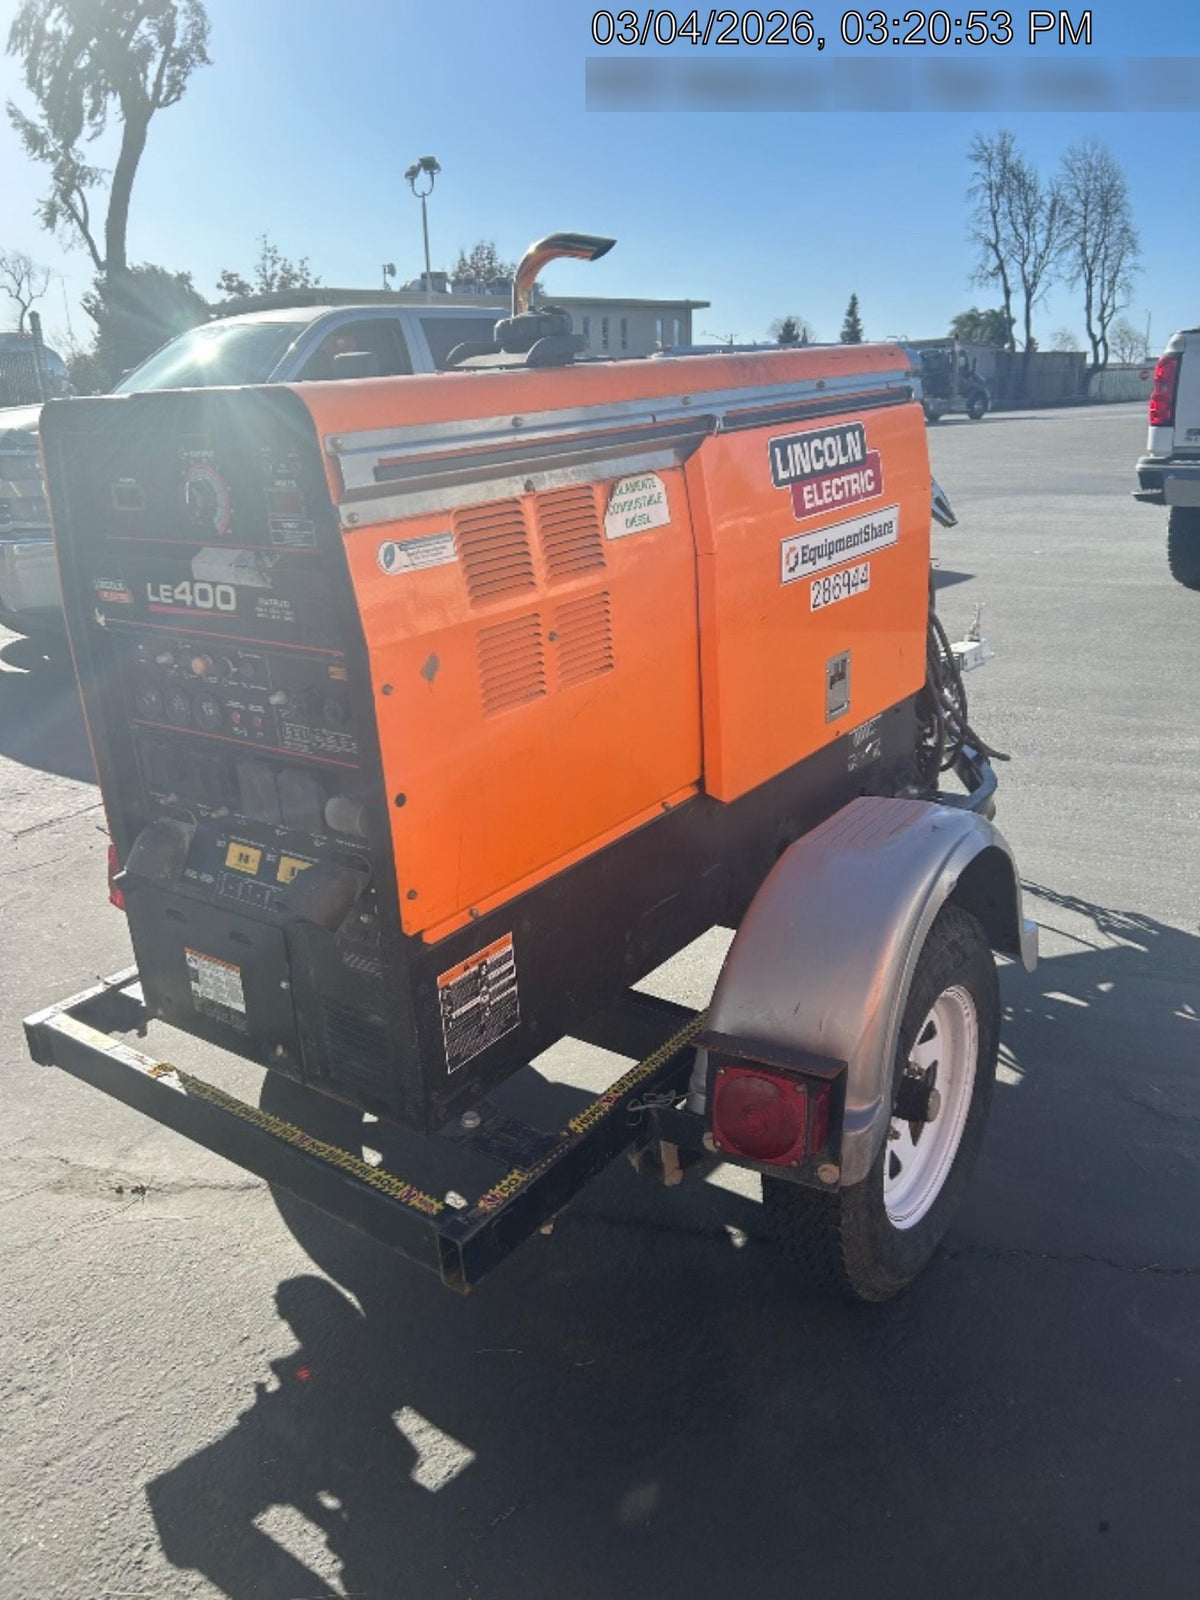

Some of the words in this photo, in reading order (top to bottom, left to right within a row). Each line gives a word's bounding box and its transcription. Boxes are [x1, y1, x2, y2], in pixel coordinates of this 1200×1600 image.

[774, 429, 863, 481] LINCOLN
[802, 468, 876, 510] ELECTRIC
[800, 519, 894, 566] EquipmentShare
[147, 581, 236, 611] LE400
[811, 562, 869, 609] 286944
